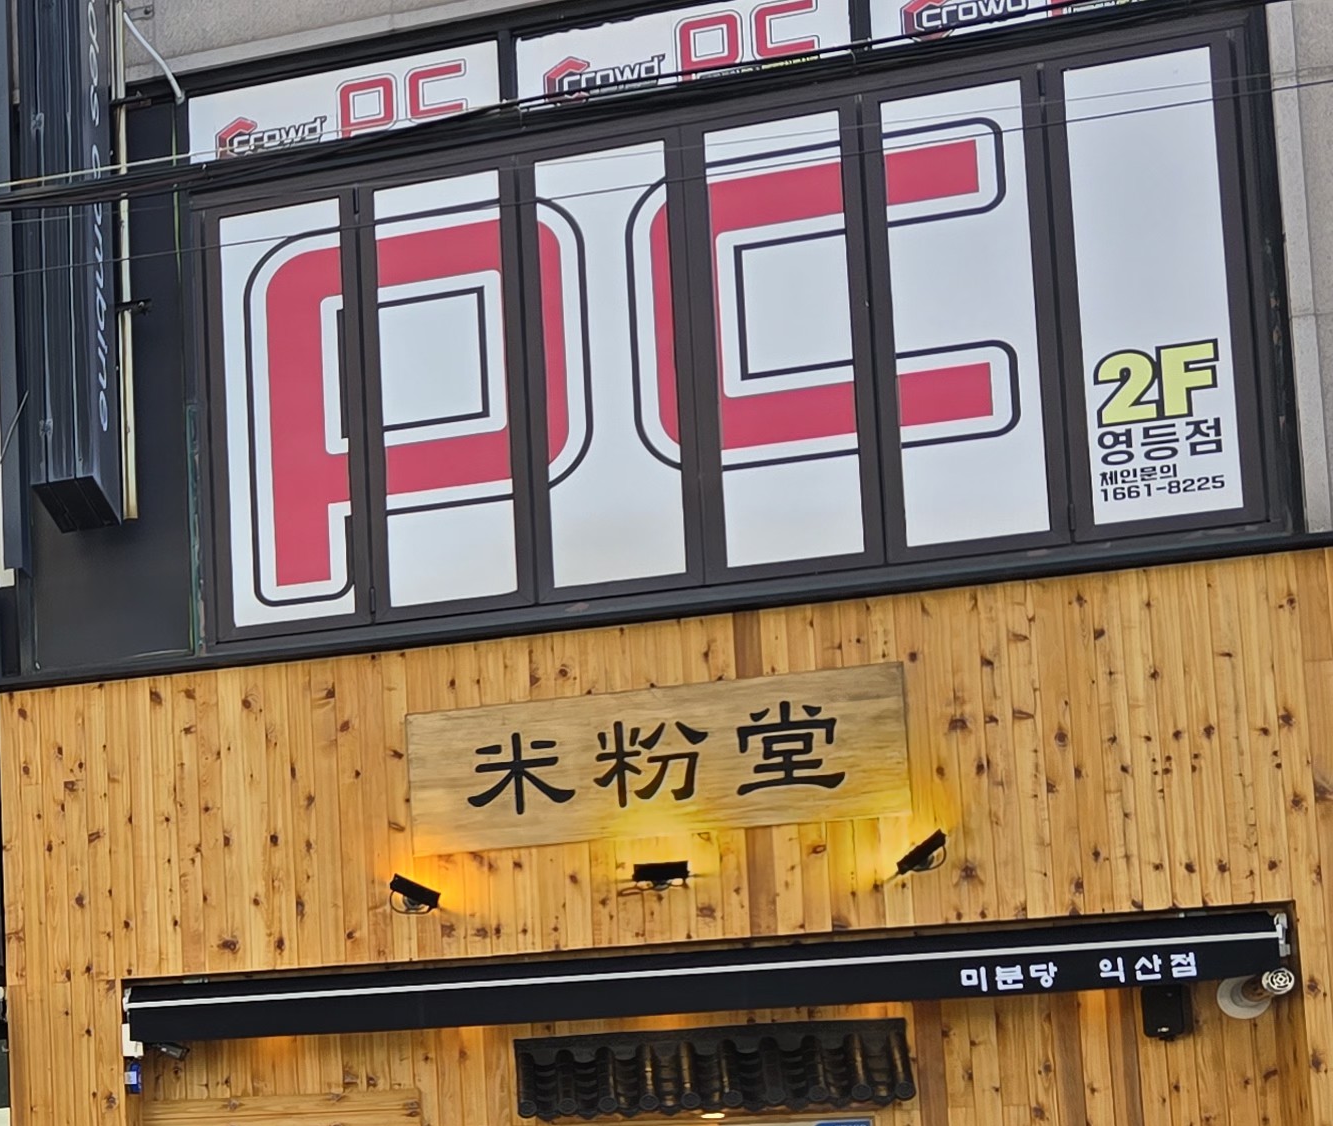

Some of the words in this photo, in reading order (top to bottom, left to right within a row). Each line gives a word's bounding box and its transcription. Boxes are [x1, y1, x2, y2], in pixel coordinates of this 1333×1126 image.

[249, 128, 1011, 600] PC
[1093, 338, 1220, 428] 2F
[1097, 417, 1223, 465] 영등점
[1100, 463, 1177, 486] 체인문의
[1100, 475, 1225, 502] 1661-8225
[467, 700, 846, 815] 米粉堂
[960, 961, 1059, 993] 미분당
[1098, 951, 1199, 984] 익산점
